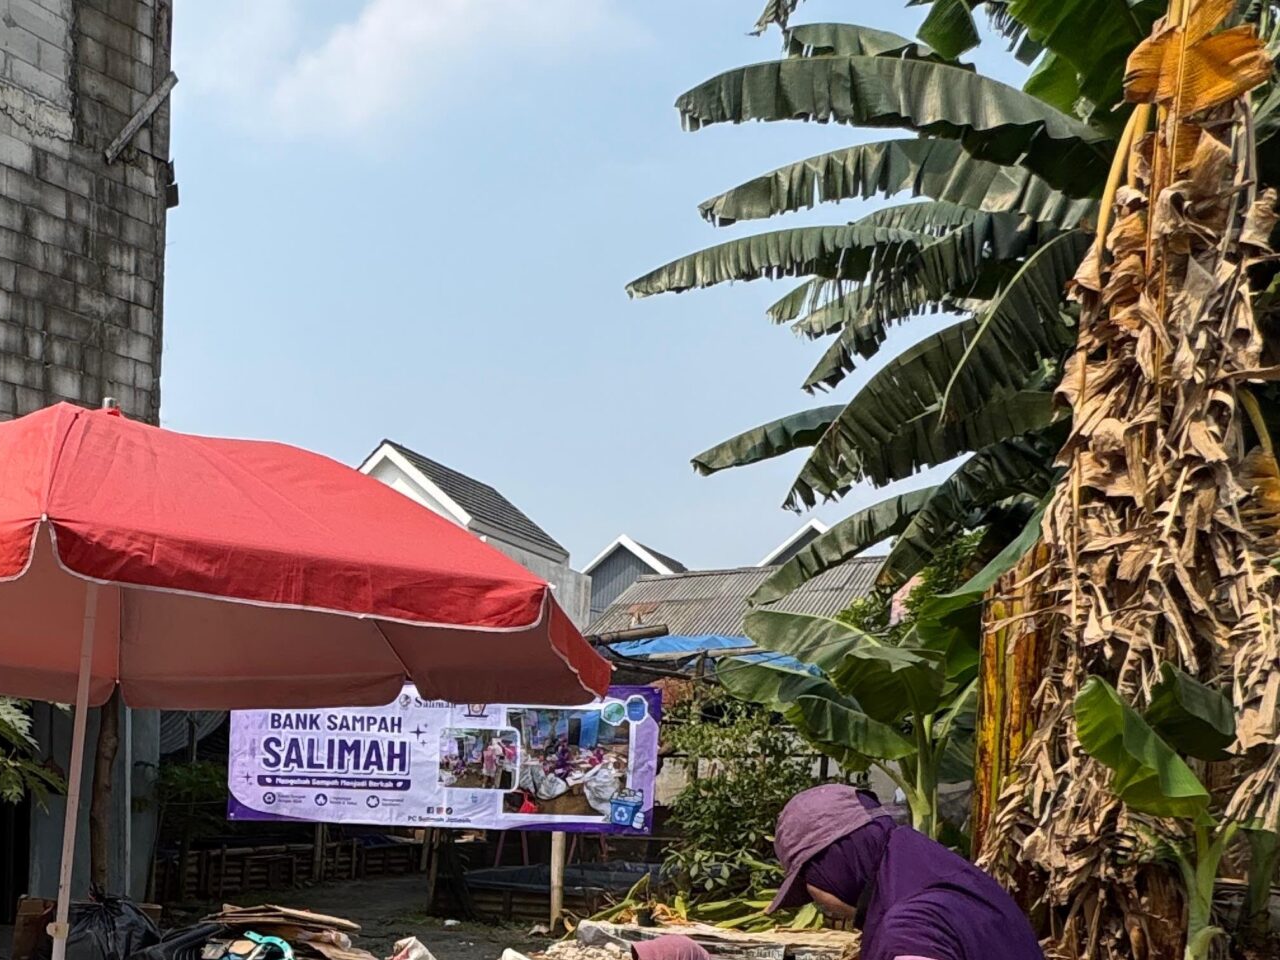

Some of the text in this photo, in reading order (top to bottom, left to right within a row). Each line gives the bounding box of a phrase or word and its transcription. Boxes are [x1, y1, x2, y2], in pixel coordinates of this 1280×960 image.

[270, 712, 403, 734] BANK SAMPAH
[261, 736, 409, 773] SALIMAH
